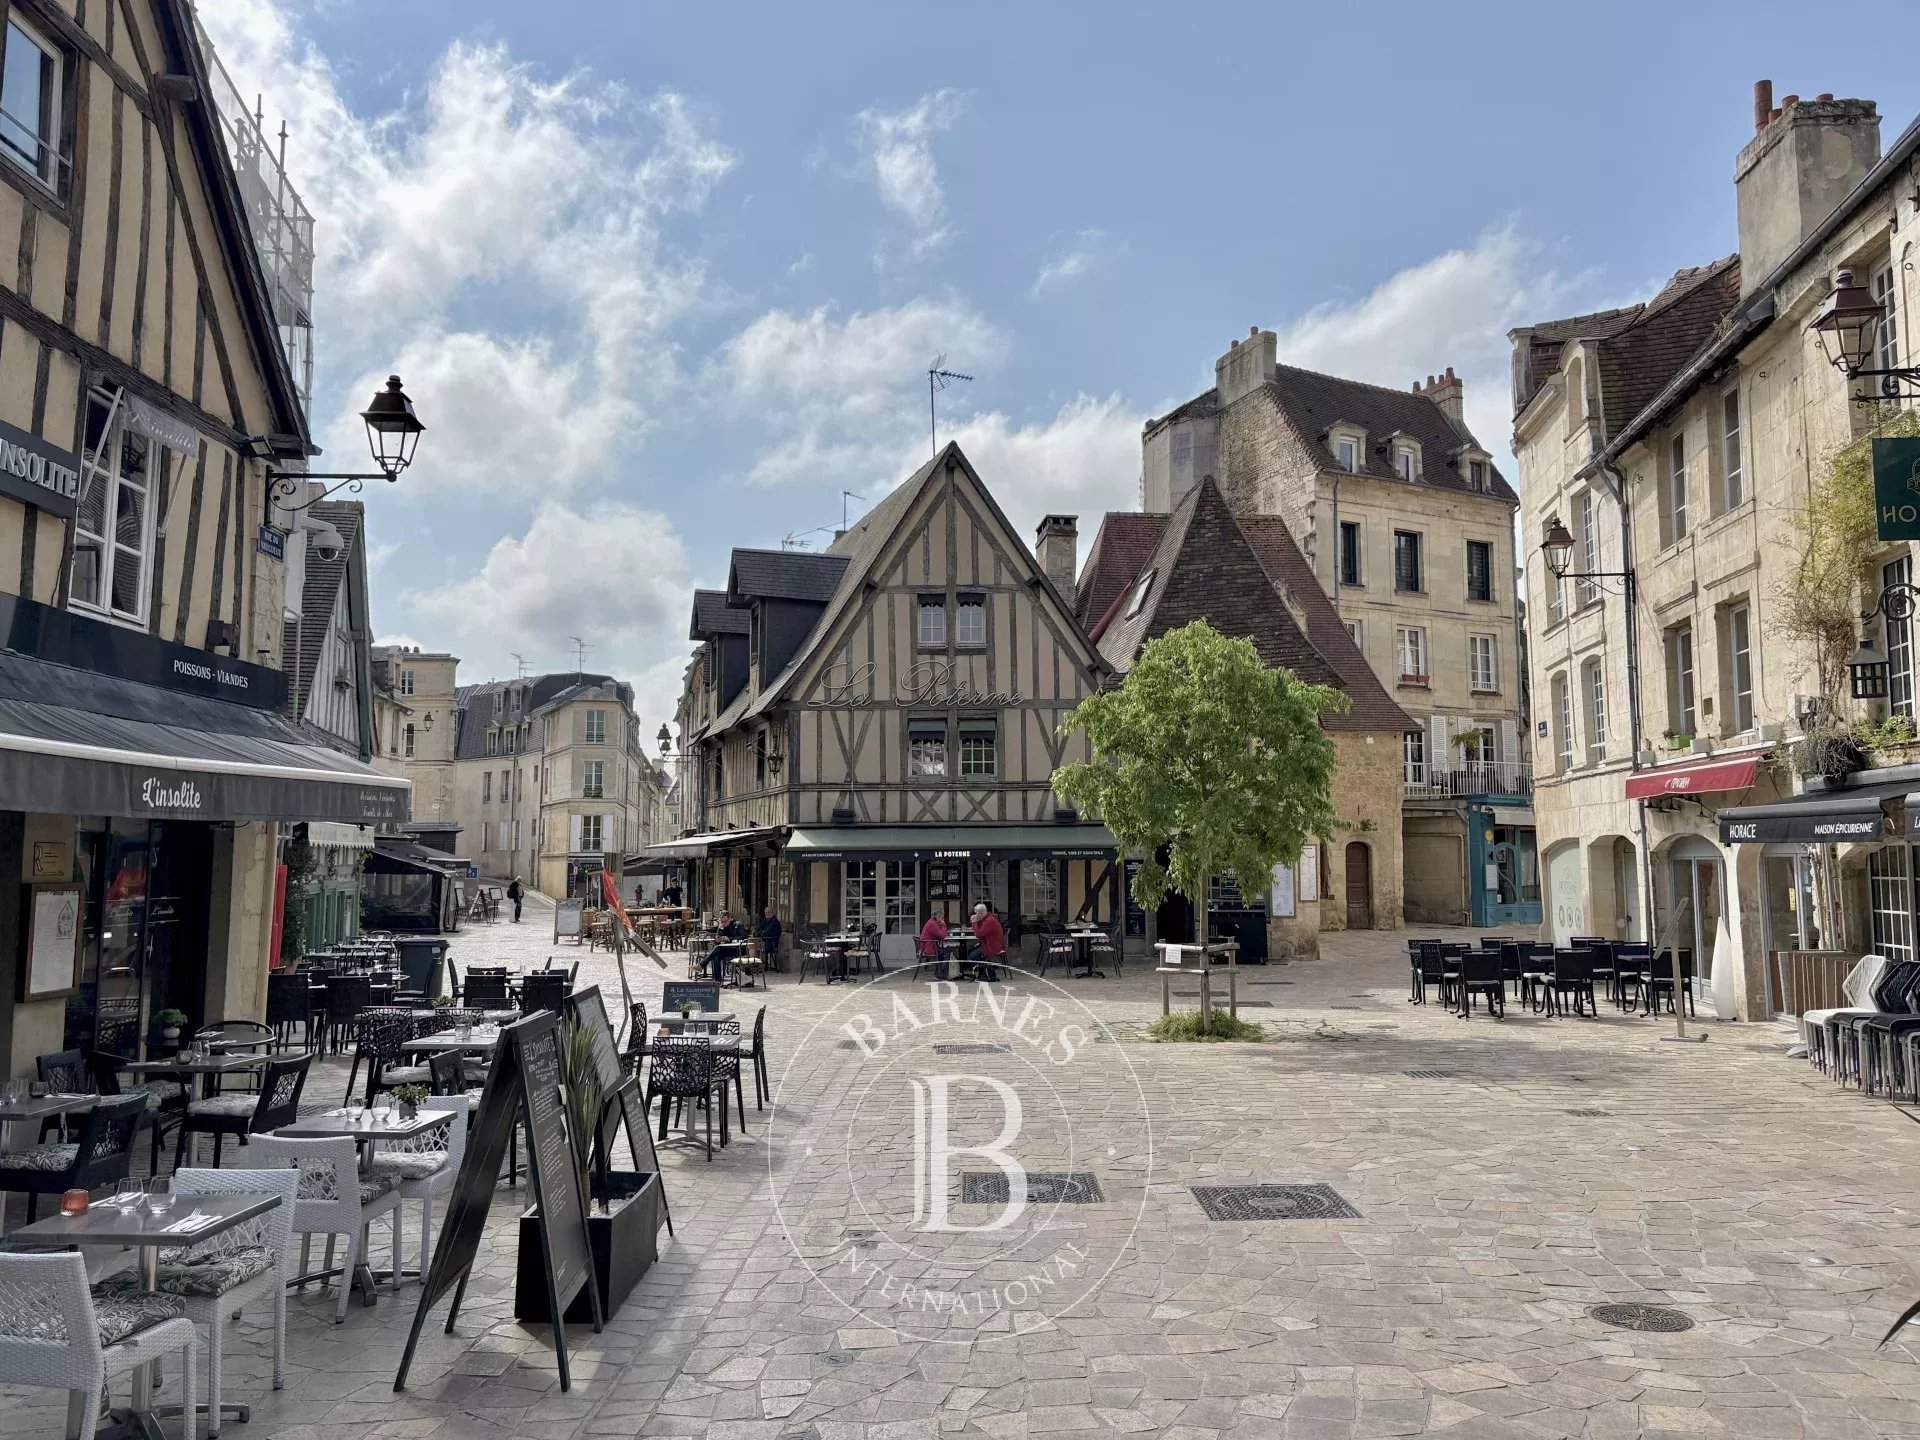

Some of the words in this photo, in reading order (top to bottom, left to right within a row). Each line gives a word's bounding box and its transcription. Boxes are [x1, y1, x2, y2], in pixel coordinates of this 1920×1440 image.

[173, 659, 212, 680] POISSONS
[217, 669, 249, 689] VIANDES
[807, 661, 877, 707] La
[894, 660, 1025, 707] Poterne
[142, 776, 202, 808] L'insolite
[1729, 823, 1757, 839] HORACE
[1814, 823, 1835, 834] MAISON
[934, 850, 943, 858] LA
[943, 850, 971, 858] POTERNE
